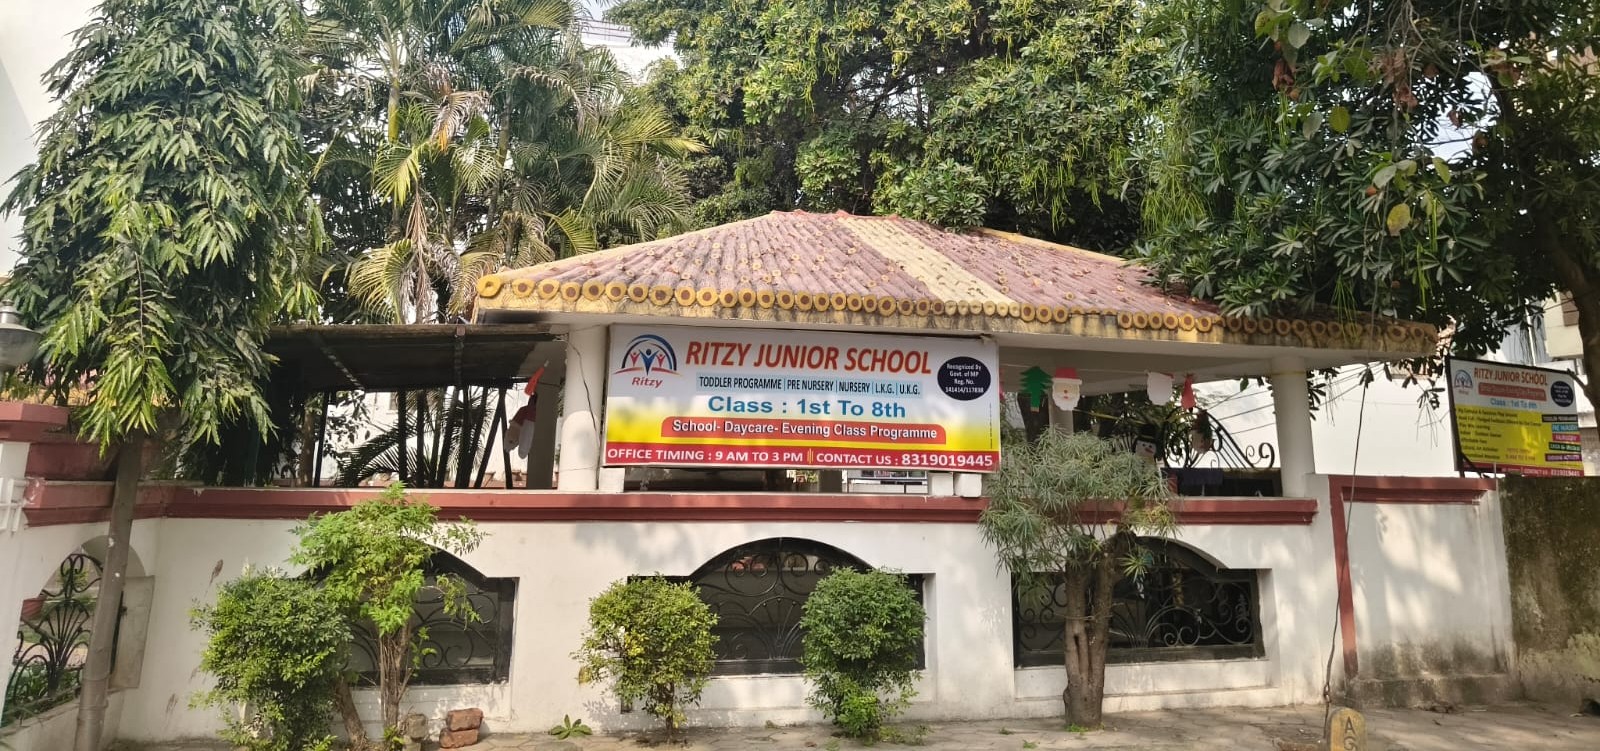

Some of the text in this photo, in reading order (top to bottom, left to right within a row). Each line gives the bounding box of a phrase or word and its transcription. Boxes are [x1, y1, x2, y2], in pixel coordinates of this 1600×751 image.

[685, 341, 932, 375] RITZY JUNIOR SCHOOL
[631, 376, 663, 388] Ritzy
[1474, 367, 1548, 385] RITZY JUNIOR SCHOOL
[700, 376, 921, 395] TODDLER PROGRAMME PRE NURSERY NURSERY L.K.G. U.K.G.
[708, 396, 773, 413] Class
[797, 398, 831, 415] 1st
[838, 399, 864, 416] To
[871, 401, 906, 418] 8th
[673, 420, 937, 440] School- Daycare- Evening Class Programme
[607, 448, 652, 459] OFFICE
[656, 449, 704, 460] TIMING
[715, 451, 723, 461] 9
[726, 451, 748, 461] AM
[752, 452, 769, 461] TO
[772, 452, 779, 462] 3
[783, 452, 803, 462] PM
[816, 453, 872, 464] CONTACT
[875, 454, 891, 465] US
[901, 453, 993, 467] 8319019445
